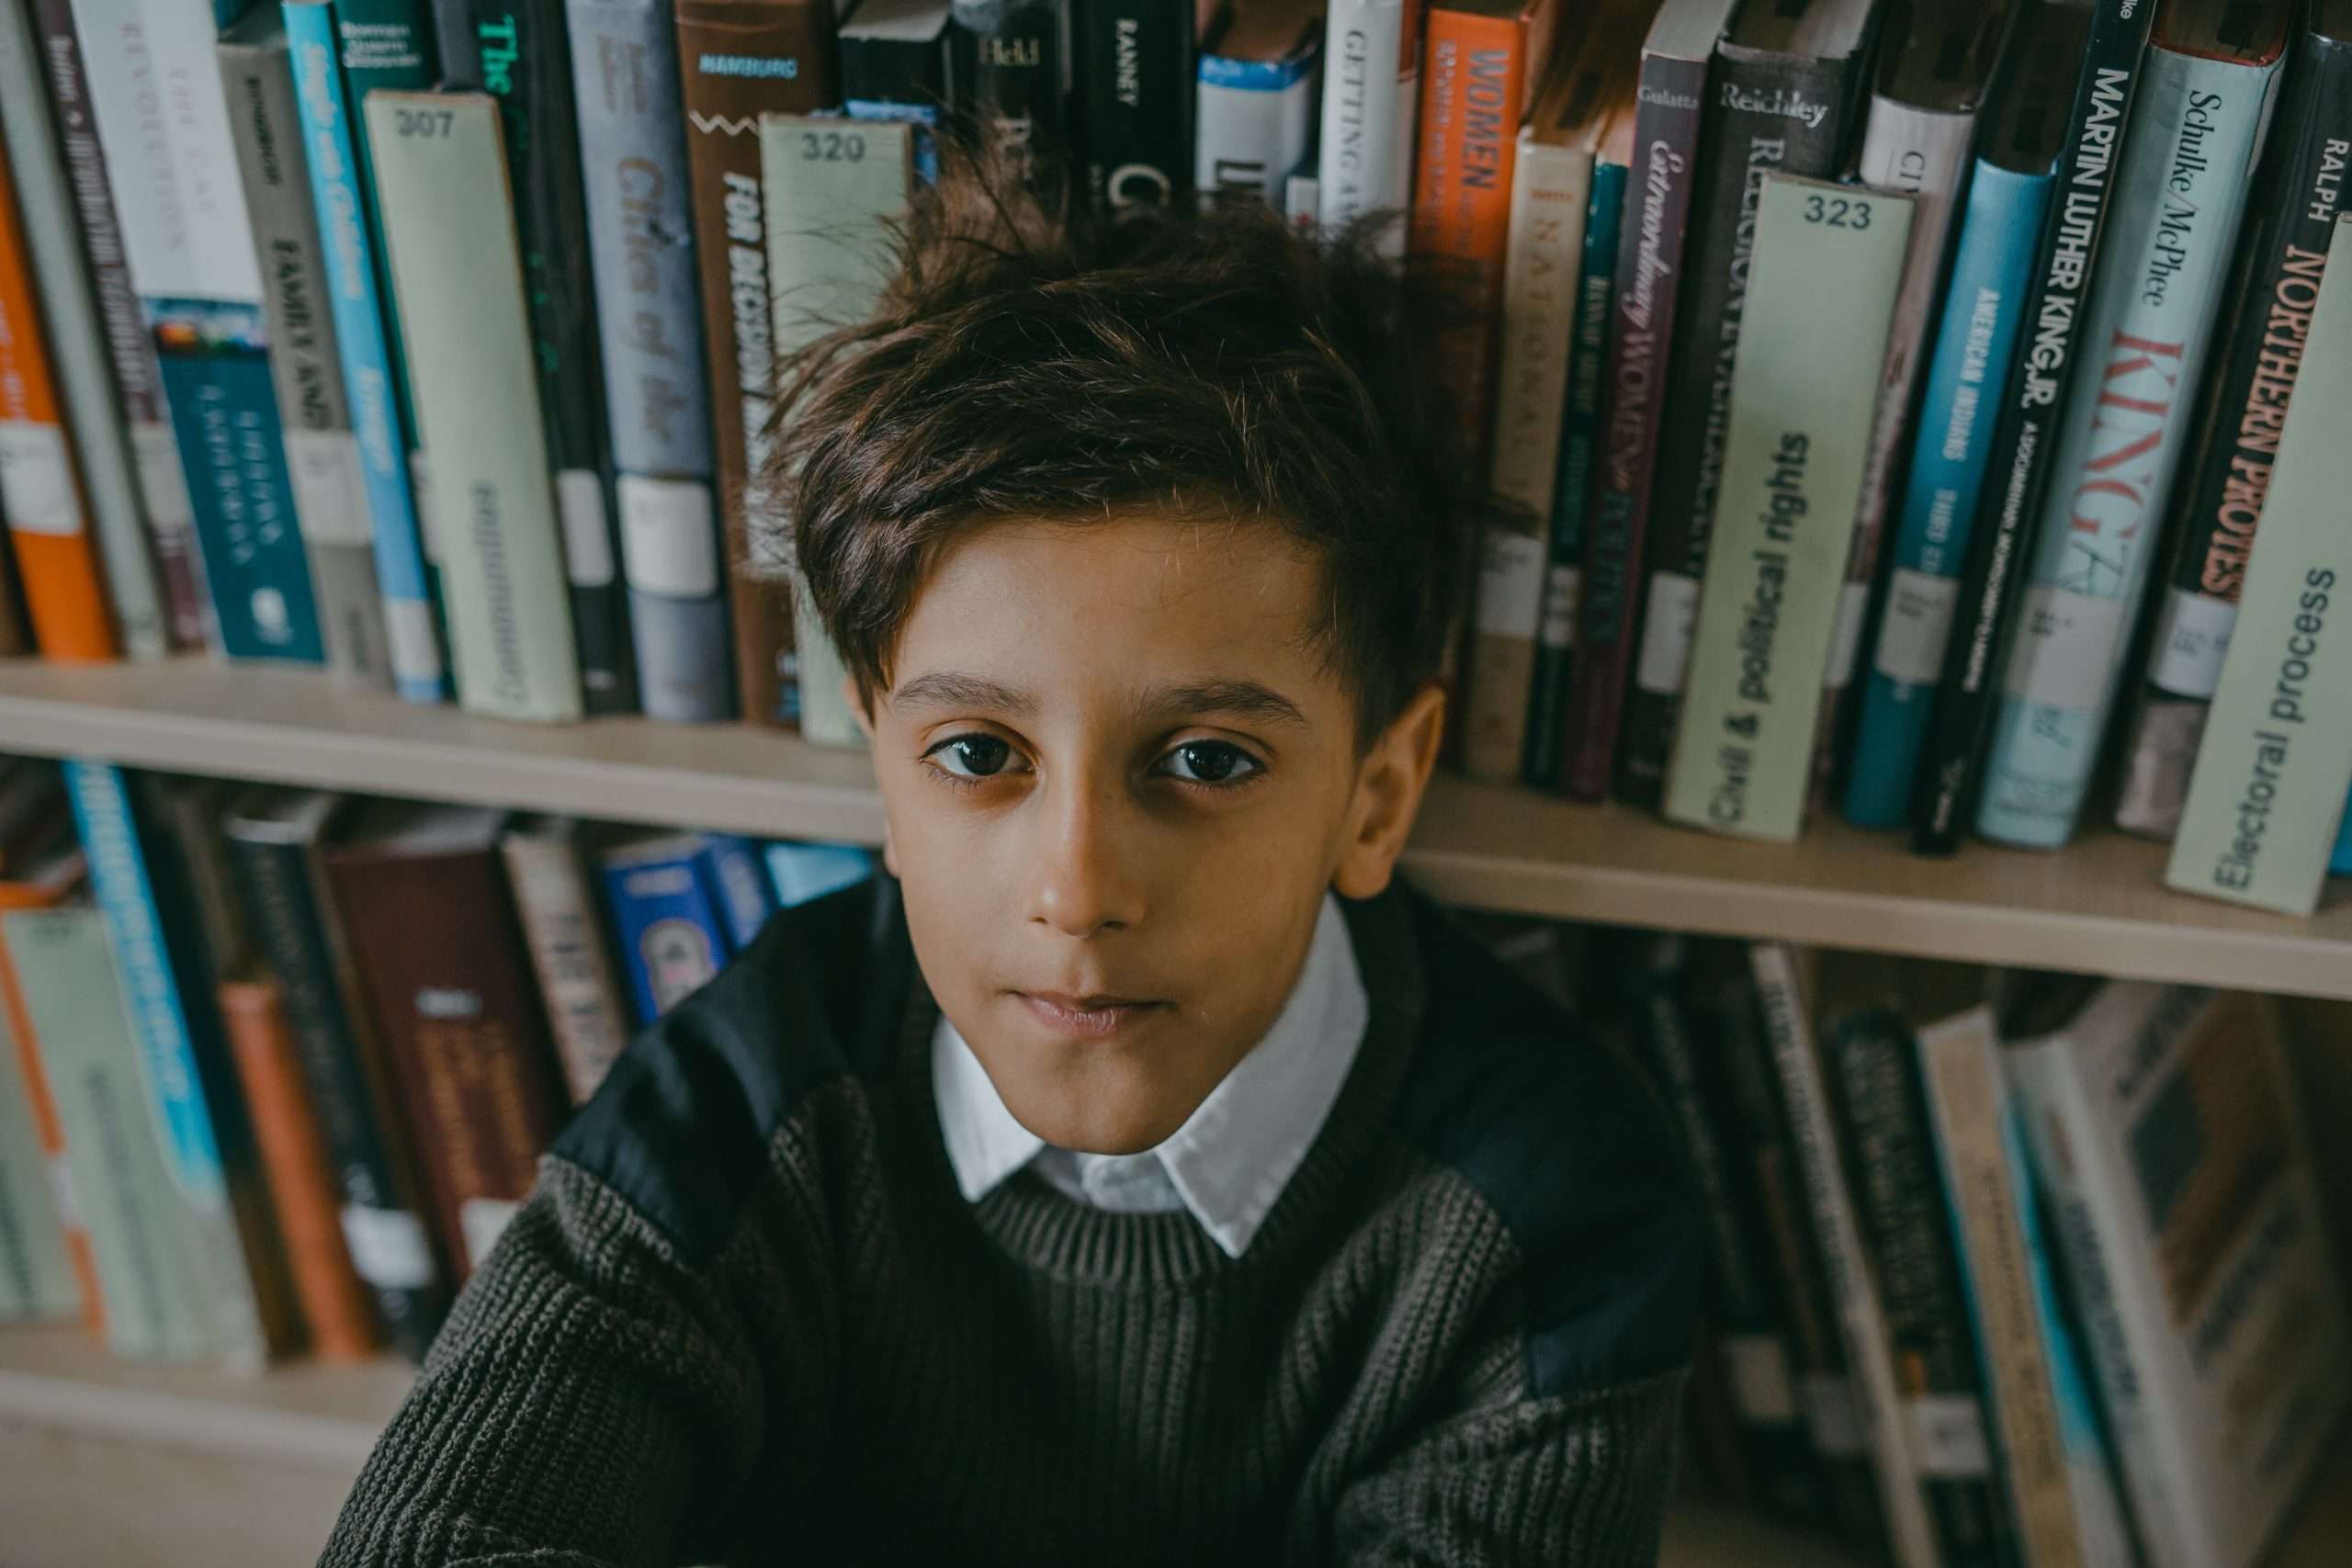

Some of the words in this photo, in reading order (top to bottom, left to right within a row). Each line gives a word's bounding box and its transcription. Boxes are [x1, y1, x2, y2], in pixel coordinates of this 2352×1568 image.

[478, 15, 518, 95] The
[1339, 28, 1367, 172] GETTING
[1718, 82, 1830, 130] Reichley
[396, 109, 455, 140] 307
[800, 132, 866, 163] 320
[1461, 48, 1512, 191] WOMEN
[2072, 67, 2130, 188] MARTIN
[722, 172, 762, 243] FOR
[1621, 140, 1685, 331] Extraordinary
[1804, 195, 1873, 231] 323
[2047, 191, 2101, 291] LUTHER
[2307, 138, 2350, 223] RALPH
[728, 245, 777, 389] DECISION
[2235, 243, 2327, 450] NORTHERN
[1610, 332, 1657, 469] WOMEN
[2069, 328, 2186, 542] KING
[1760, 431, 1811, 542] rights
[1737, 547, 1792, 705] political
[2212, 728, 2290, 893] Electoral
[2268, 566, 2338, 725] process
